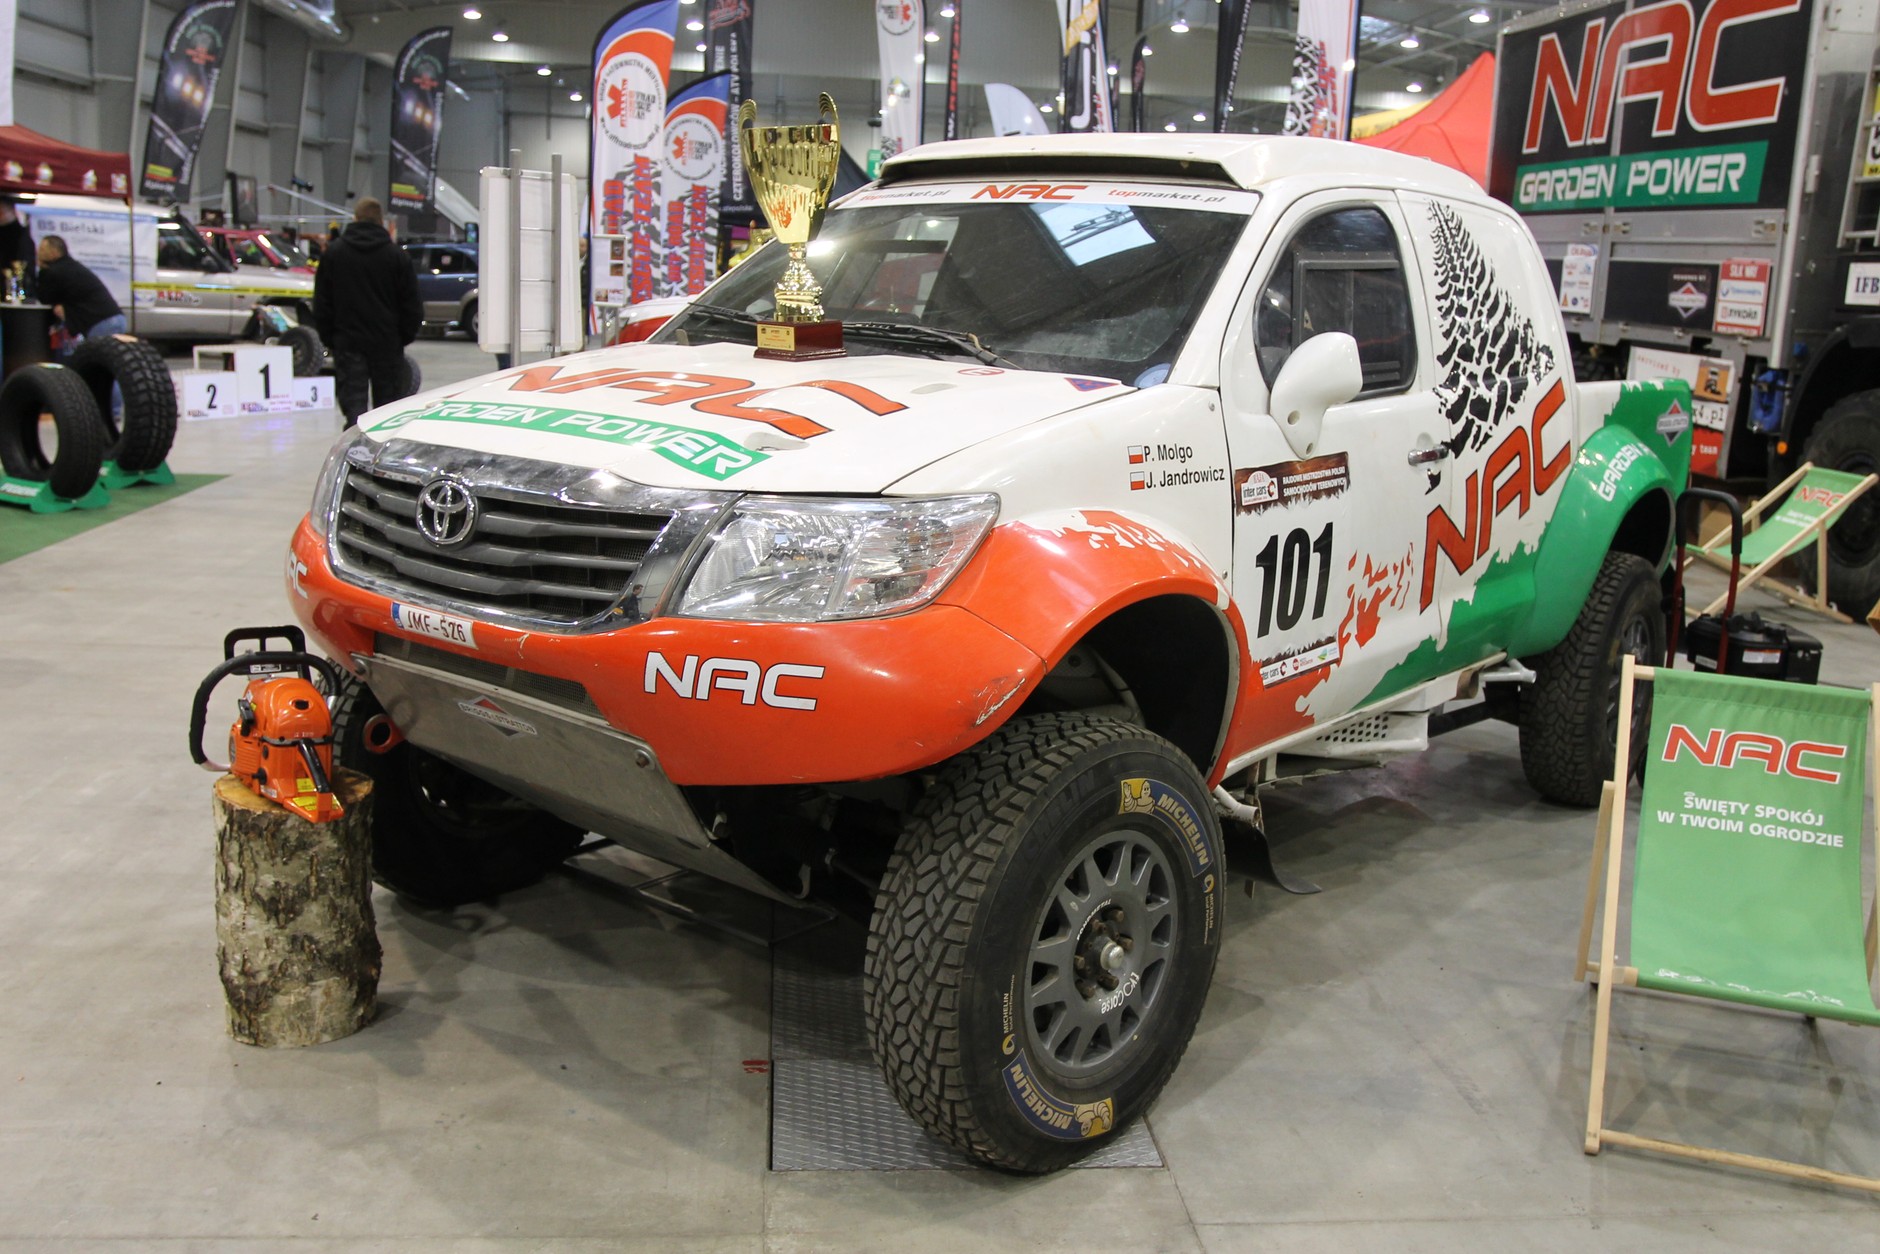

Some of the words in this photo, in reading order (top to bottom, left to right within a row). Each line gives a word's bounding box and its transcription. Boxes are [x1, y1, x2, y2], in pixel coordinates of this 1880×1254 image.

[1522, 0, 1800, 154] NAC
[970, 184, 1089, 200] NAC
[1108, 189, 1227, 203] topmarket.pl
[1519, 163, 1617, 204] GARDEN
[1626, 153, 1747, 197] POWER
[630, 231, 653, 304] ESCUE
[206, 384, 217, 410] 2
[259, 363, 271, 399] 1
[310, 386, 318, 402] 3
[550, 415, 755, 475] POWER
[1144, 446, 1155, 462] P.
[1157, 443, 1194, 466] Molgo
[1146, 471, 1157, 488] J.
[1160, 467, 1225, 488] Jandrowicz
[1243, 486, 1255, 498] inter
[1256, 484, 1267, 496] cars
[1598, 443, 1643, 502] GARDEN
[1420, 377, 1571, 616] NAC
[1256, 521, 1333, 639] 101
[407, 610, 466, 643] JMF-526
[643, 651, 825, 712] NAC
[1661, 723, 1848, 785] NAC
[1158, 793, 1209, 866] MICHELIN
[1657, 810, 1675, 824] W
[1680, 813, 1744, 833] TWOIM
[1749, 822, 1844, 848] OGRODZIE
[1683, 791, 1750, 816] ŚWIĘTY
[1754, 802, 1825, 827] SPOKÓJ
[1010, 1064, 1073, 1130] MICHELIN
